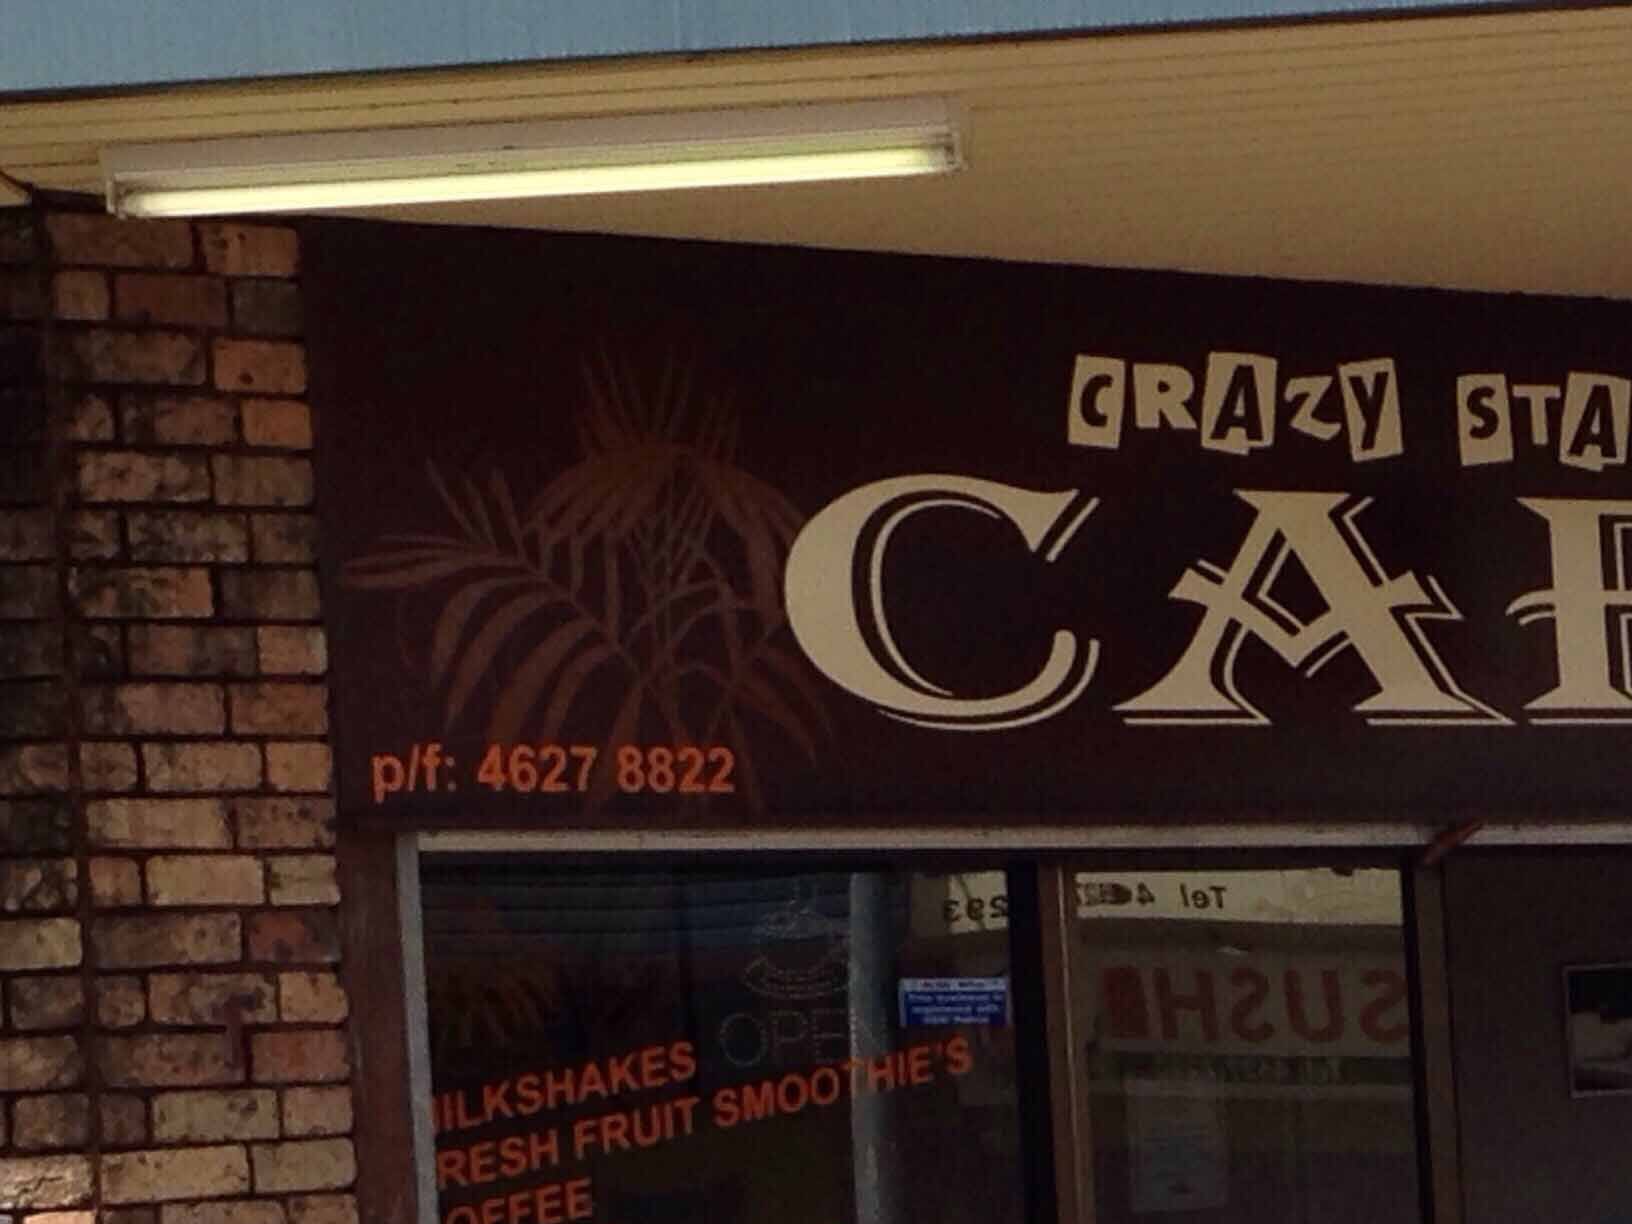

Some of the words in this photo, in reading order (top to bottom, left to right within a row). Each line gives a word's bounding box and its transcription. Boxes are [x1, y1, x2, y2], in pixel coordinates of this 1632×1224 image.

[1067, 352, 1403, 462] CRAZY
[371, 747, 456, 802] p/f:
[477, 746, 598, 794] 4627
[616, 746, 735, 794] 8822
[431, 1041, 697, 1131] ILKSHAKES
[437, 1129, 559, 1190] RESH
[573, 1098, 700, 1161] FRUIT
[712, 1035, 974, 1129] SMOOTHIE'S
